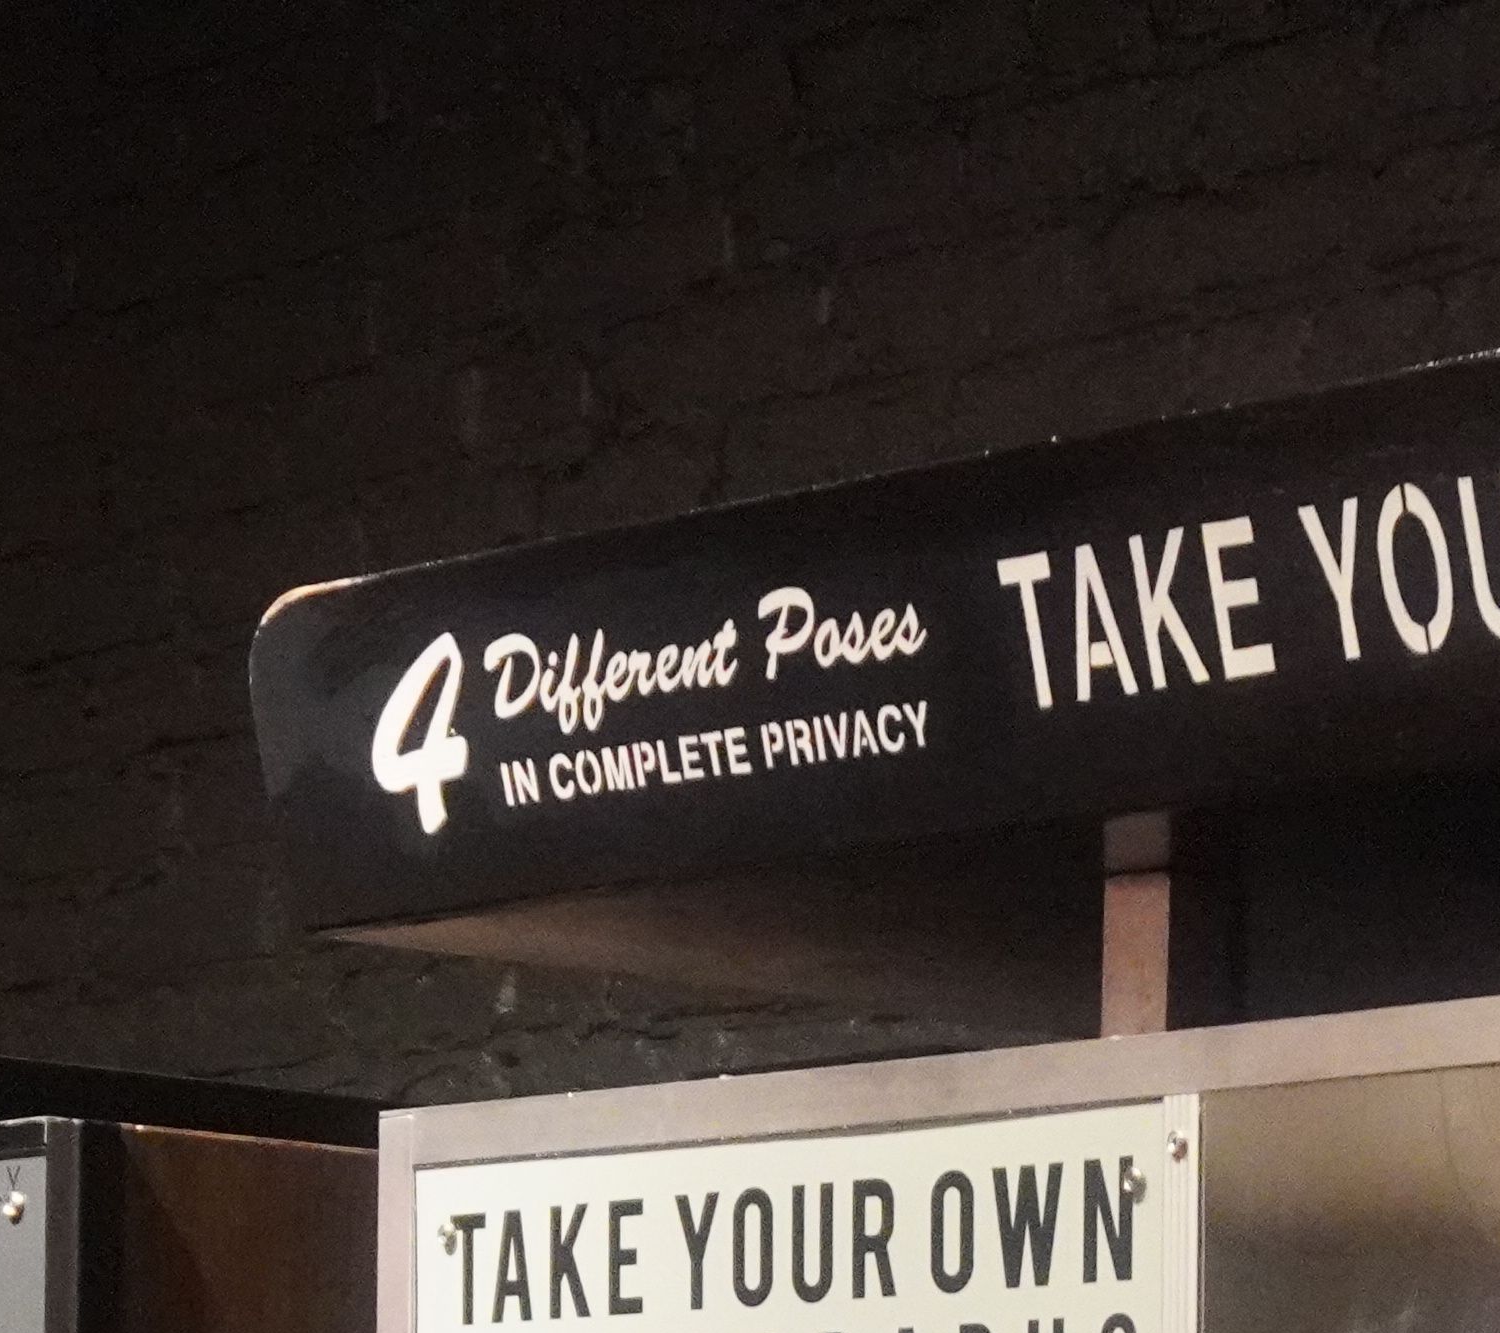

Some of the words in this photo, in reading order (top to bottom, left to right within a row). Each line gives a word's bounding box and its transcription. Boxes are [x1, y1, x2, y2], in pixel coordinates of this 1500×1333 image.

[997, 514, 1277, 712] TAKE
[372, 631, 469, 836] 4
[484, 618, 738, 734] Different
[757, 586, 928, 681] Poses
[500, 758, 540, 806] IN
[548, 725, 753, 800] COMPLETE
[762, 701, 928, 769] PRIVACY
[453, 1199, 644, 1325] TAKE
[675, 1177, 897, 1311] YOUR
[930, 1155, 1135, 1294] OWN
